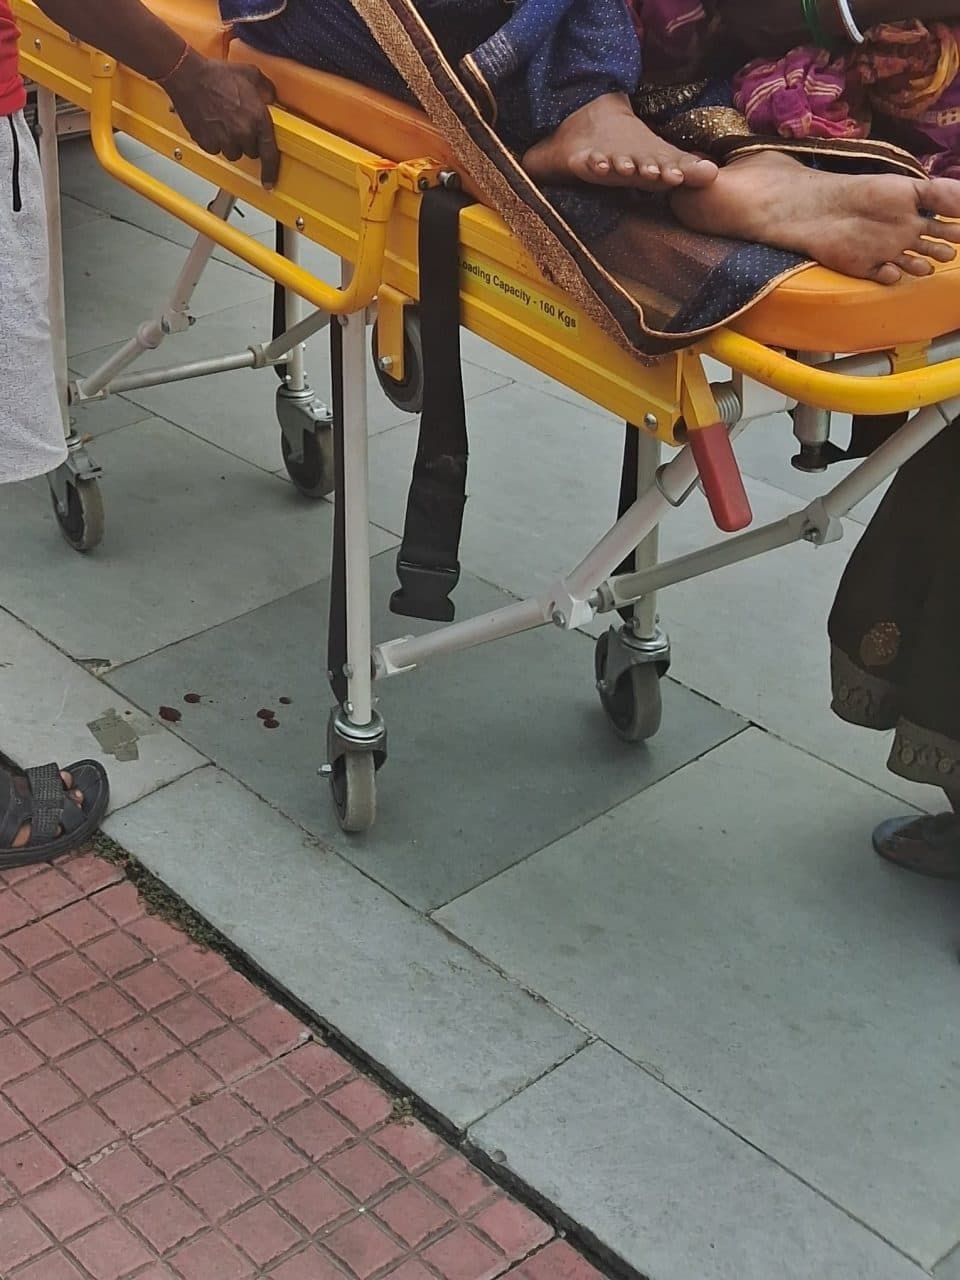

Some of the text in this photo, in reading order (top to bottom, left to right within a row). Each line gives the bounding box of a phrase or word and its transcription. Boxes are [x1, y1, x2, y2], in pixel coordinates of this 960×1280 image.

[493, 275, 531, 305] Capacity
[539, 300, 555, 317] 160
[557, 309, 577, 328] Kgs
